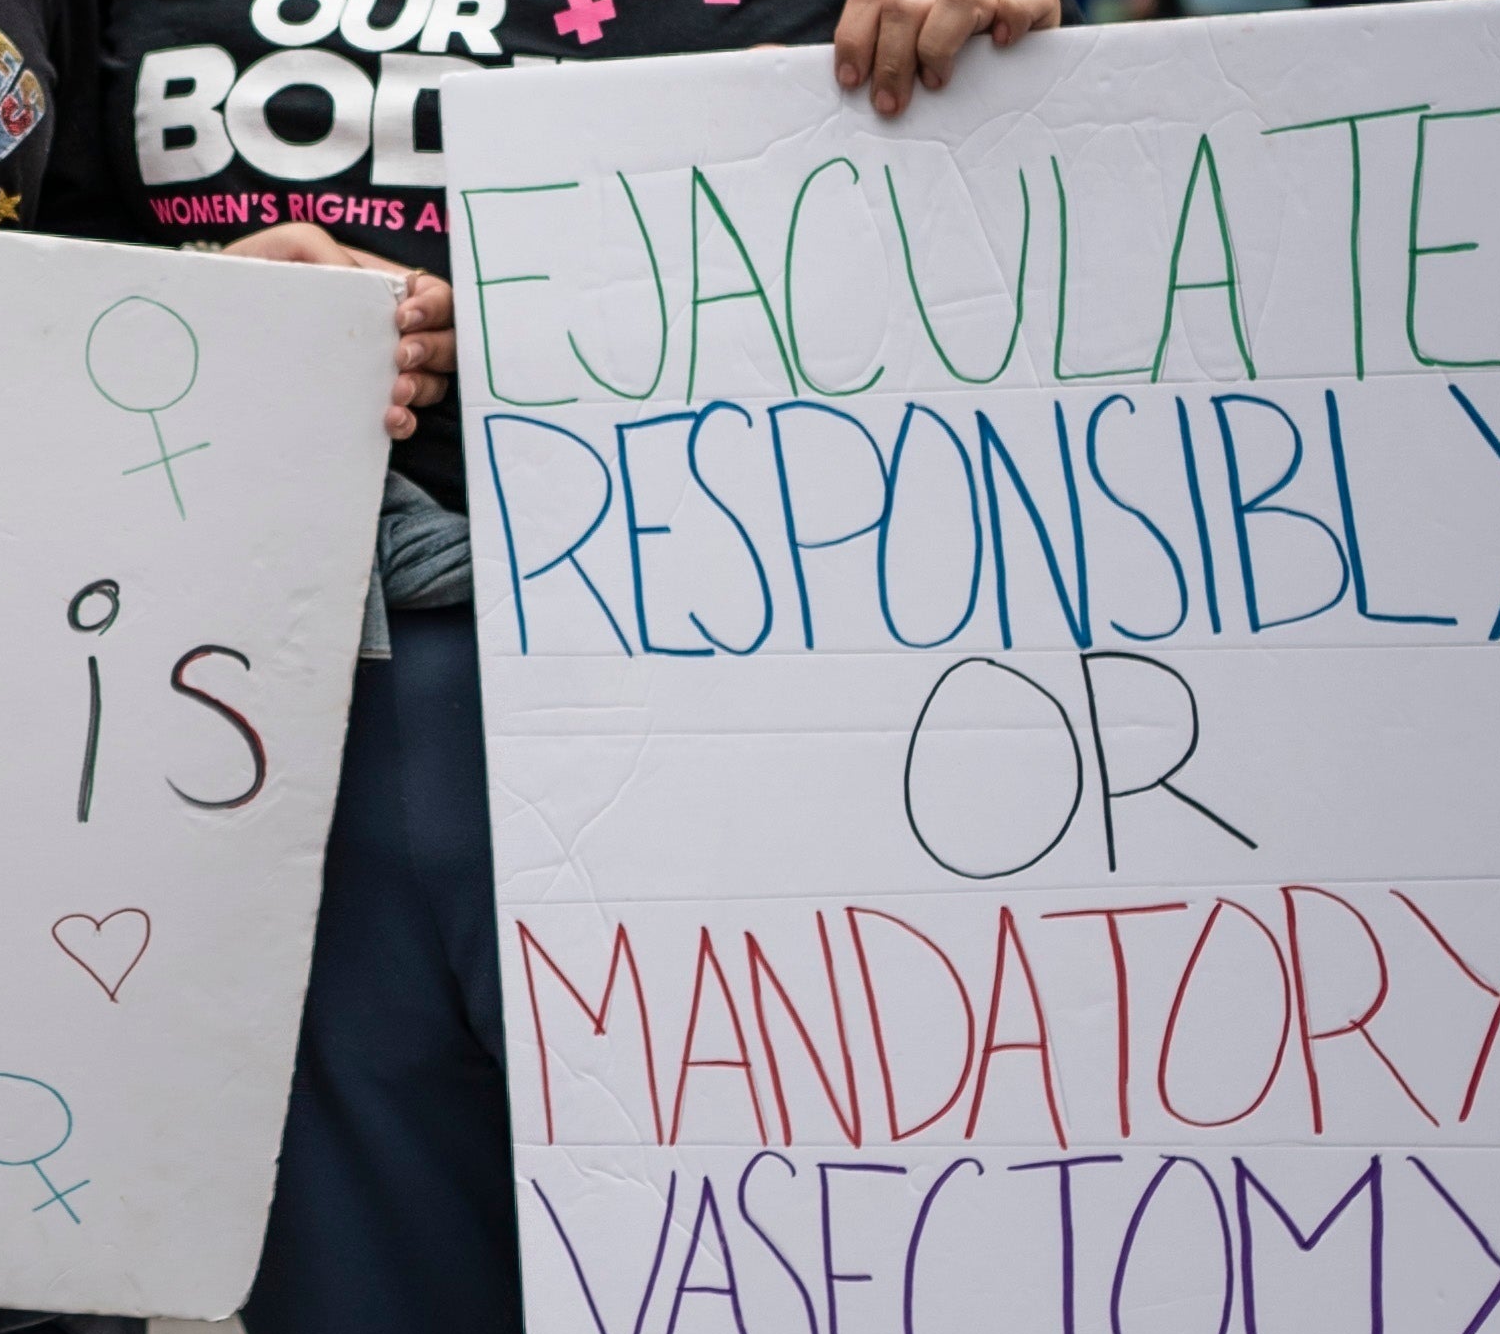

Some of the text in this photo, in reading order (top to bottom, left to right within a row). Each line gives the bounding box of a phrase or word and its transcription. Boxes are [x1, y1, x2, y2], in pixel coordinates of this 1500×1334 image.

[150, 192, 280, 226] WOMEN'S
[288, 193, 405, 233] RIGHTS
[68, 578, 267, 823] is
[903, 651, 1258, 880] OR
